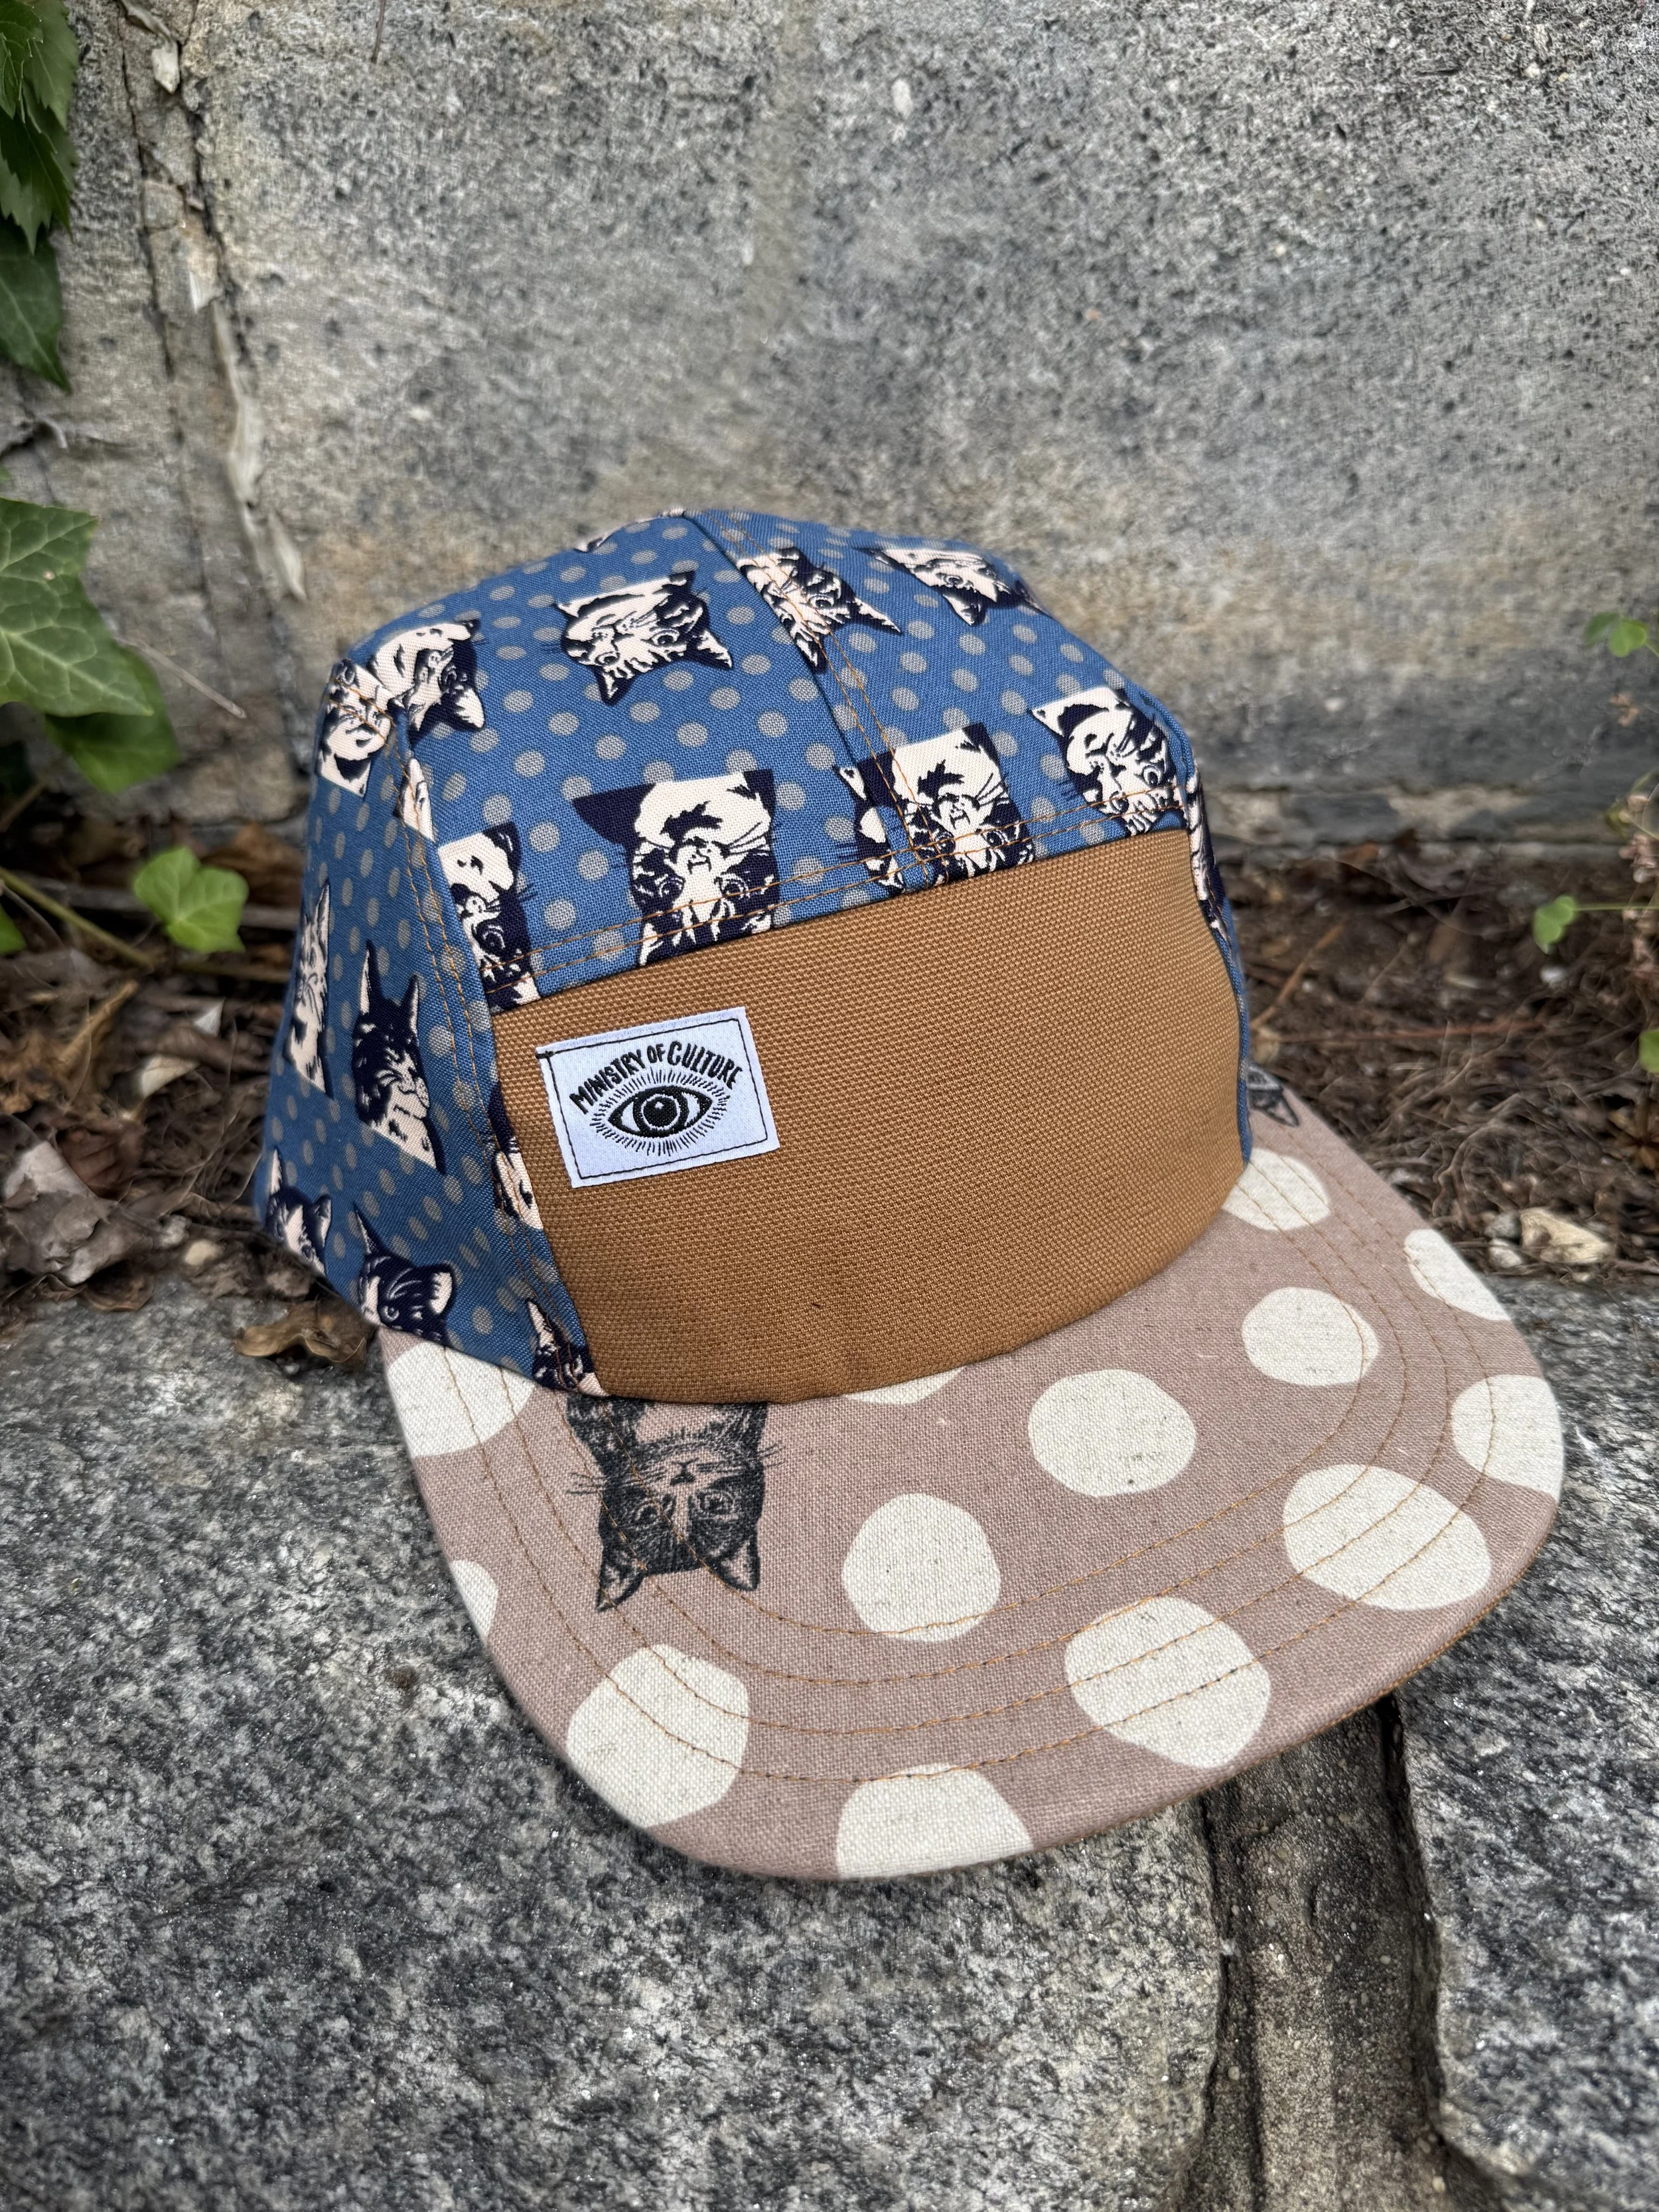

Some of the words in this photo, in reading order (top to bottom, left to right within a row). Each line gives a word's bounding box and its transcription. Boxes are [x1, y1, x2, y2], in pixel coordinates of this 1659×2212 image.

[569, 1049, 648, 1115] MINISTRY
[646, 1043, 666, 1064] OF
[667, 1041, 743, 1090] CULTURE
